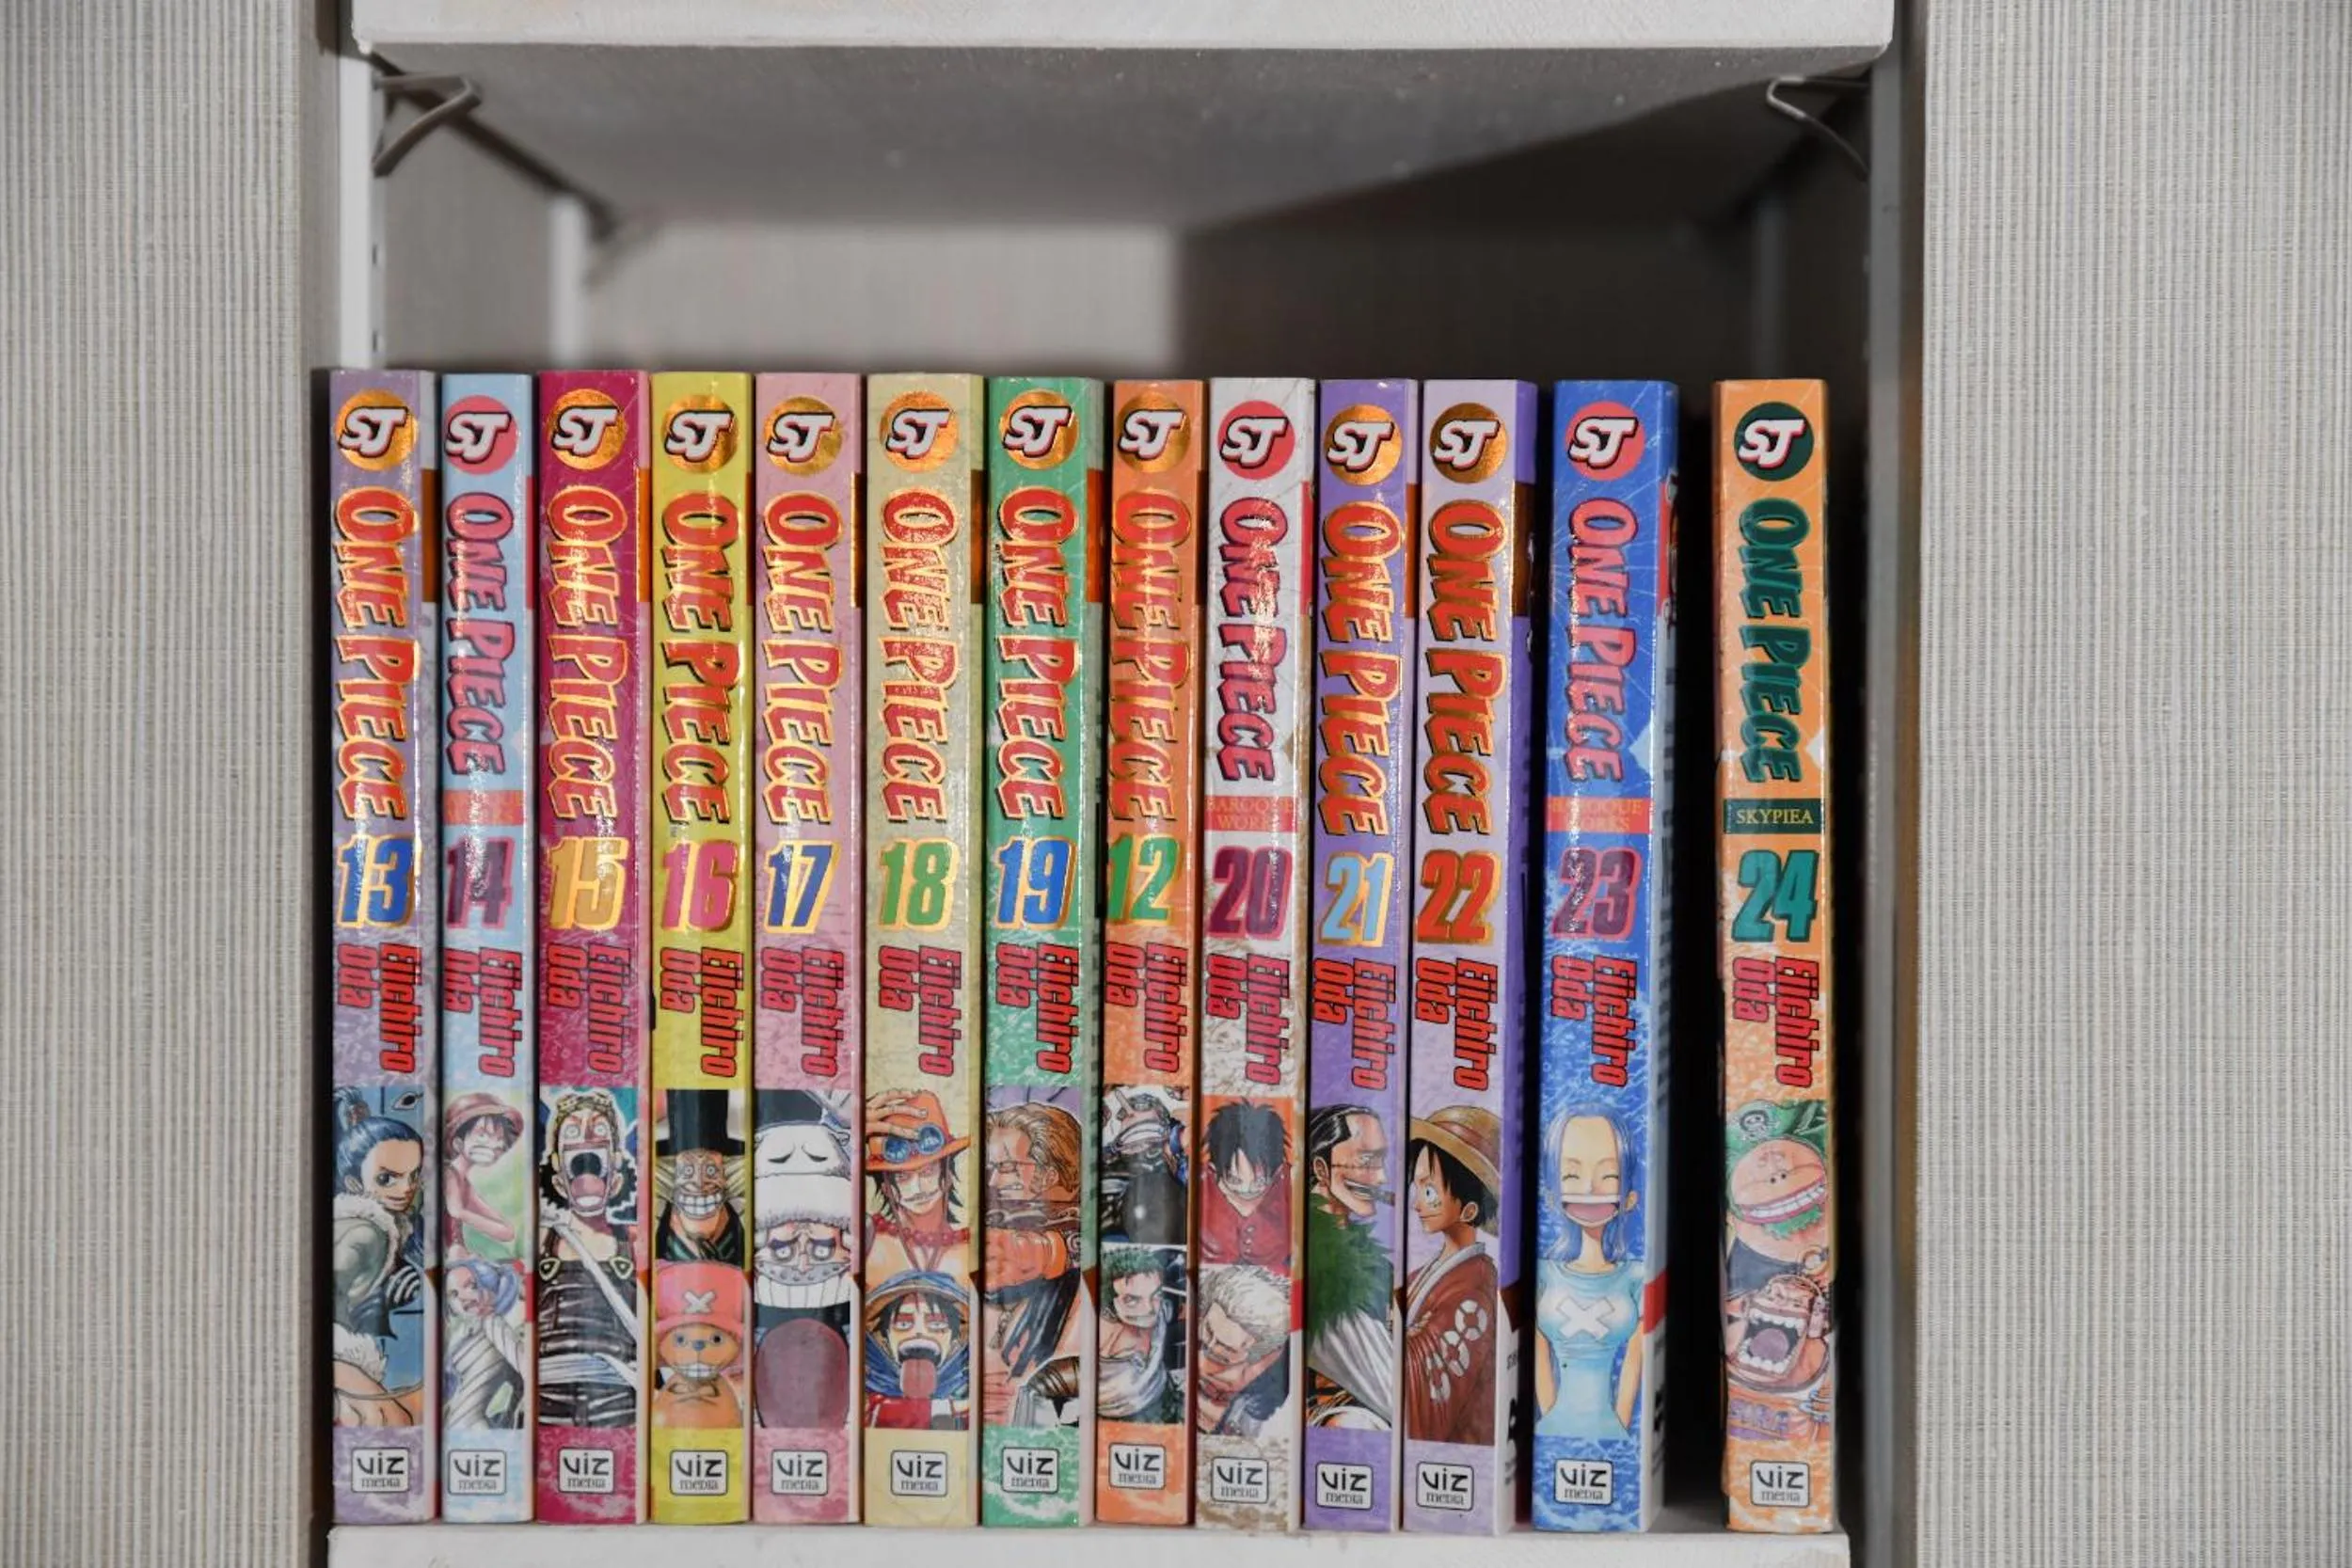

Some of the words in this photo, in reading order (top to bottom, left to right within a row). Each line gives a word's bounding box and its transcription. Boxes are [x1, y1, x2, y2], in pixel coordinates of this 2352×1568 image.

[334, 485, 420, 627] ONE
[446, 492, 514, 611] ONE
[546, 485, 628, 626] ONE
[660, 489, 741, 631] ONE
[763, 490, 843, 632] ONE
[881, 488, 960, 630] ONE
[996, 485, 1079, 627] ONE
[1111, 488, 1191, 630] ONE
[1219, 497, 1288, 618] ONE
[1321, 500, 1403, 642] ONE
[1427, 499, 1508, 642] ONE
[1568, 498, 1638, 618] ONE
[1738, 498, 1810, 619] ONE
[334, 634, 420, 820] PIECE
[446, 618, 515, 775] PIECE
[547, 634, 628, 820] PIECE
[660, 637, 743, 824] PIECE
[762, 639, 843, 824] PIECE
[879, 635, 960, 825] PIECE
[996, 634, 1080, 820] PIECE
[1109, 636, 1191, 821] PIECE
[1217, 623, 1288, 782] PIECE
[1319, 649, 1403, 835] PIECE
[1422, 648, 1507, 835] PIECE
[1565, 625, 1636, 783] PIECE
[1740, 625, 1811, 783] PIECE
[336, 833, 421, 929] 13
[1107, 833, 1183, 926] 12
[1736, 809, 1814, 824] SKYPIEA
[446, 836, 516, 929] 14
[548, 836, 629, 930] 15
[661, 838, 739, 932] 16
[764, 839, 842, 934] 17
[879, 837, 960, 932] 18
[994, 835, 1076, 930] 19
[1208, 846, 1293, 941] 20
[1319, 851, 1393, 947] 21
[1416, 848, 1502, 945] 22
[1552, 846, 1642, 940] 23
[1731, 849, 1820, 942] 24
[337, 943, 379, 1009] Oda
[379, 942, 422, 1073] Eiichiro
[443, 947, 480, 1013] Oda
[479, 946, 522, 1077] Eiichiro
[547, 942, 587, 1009] Oda
[587, 943, 631, 1074] Eiichiro
[660, 946, 701, 1013] Oda
[701, 945, 744, 1077] Eiichiro
[760, 946, 803, 1013] Oda
[802, 945, 844, 1077] Eiichiro
[878, 945, 919, 1011] Oda
[918, 944, 961, 1077] Eiichiro
[995, 942, 1037, 1008] Oda
[1036, 942, 1079, 1074] Eiichiro
[1104, 942, 1145, 1007] Oda
[1144, 942, 1188, 1073] Eiichiro
[1206, 953, 1248, 1020] Oda
[1245, 953, 1290, 1085] Eiichiro
[1312, 958, 1354, 1024] Oda
[1351, 958, 1396, 1090] Eiichiro
[1415, 958, 1457, 1024] Oda
[1454, 958, 1499, 1091] Eiichiro
[1550, 955, 1593, 1022] Oda
[1591, 955, 1637, 1087] Eiichiro
[1732, 956, 1775, 1023] Oda
[1774, 956, 1820, 1088] Eiichiro
